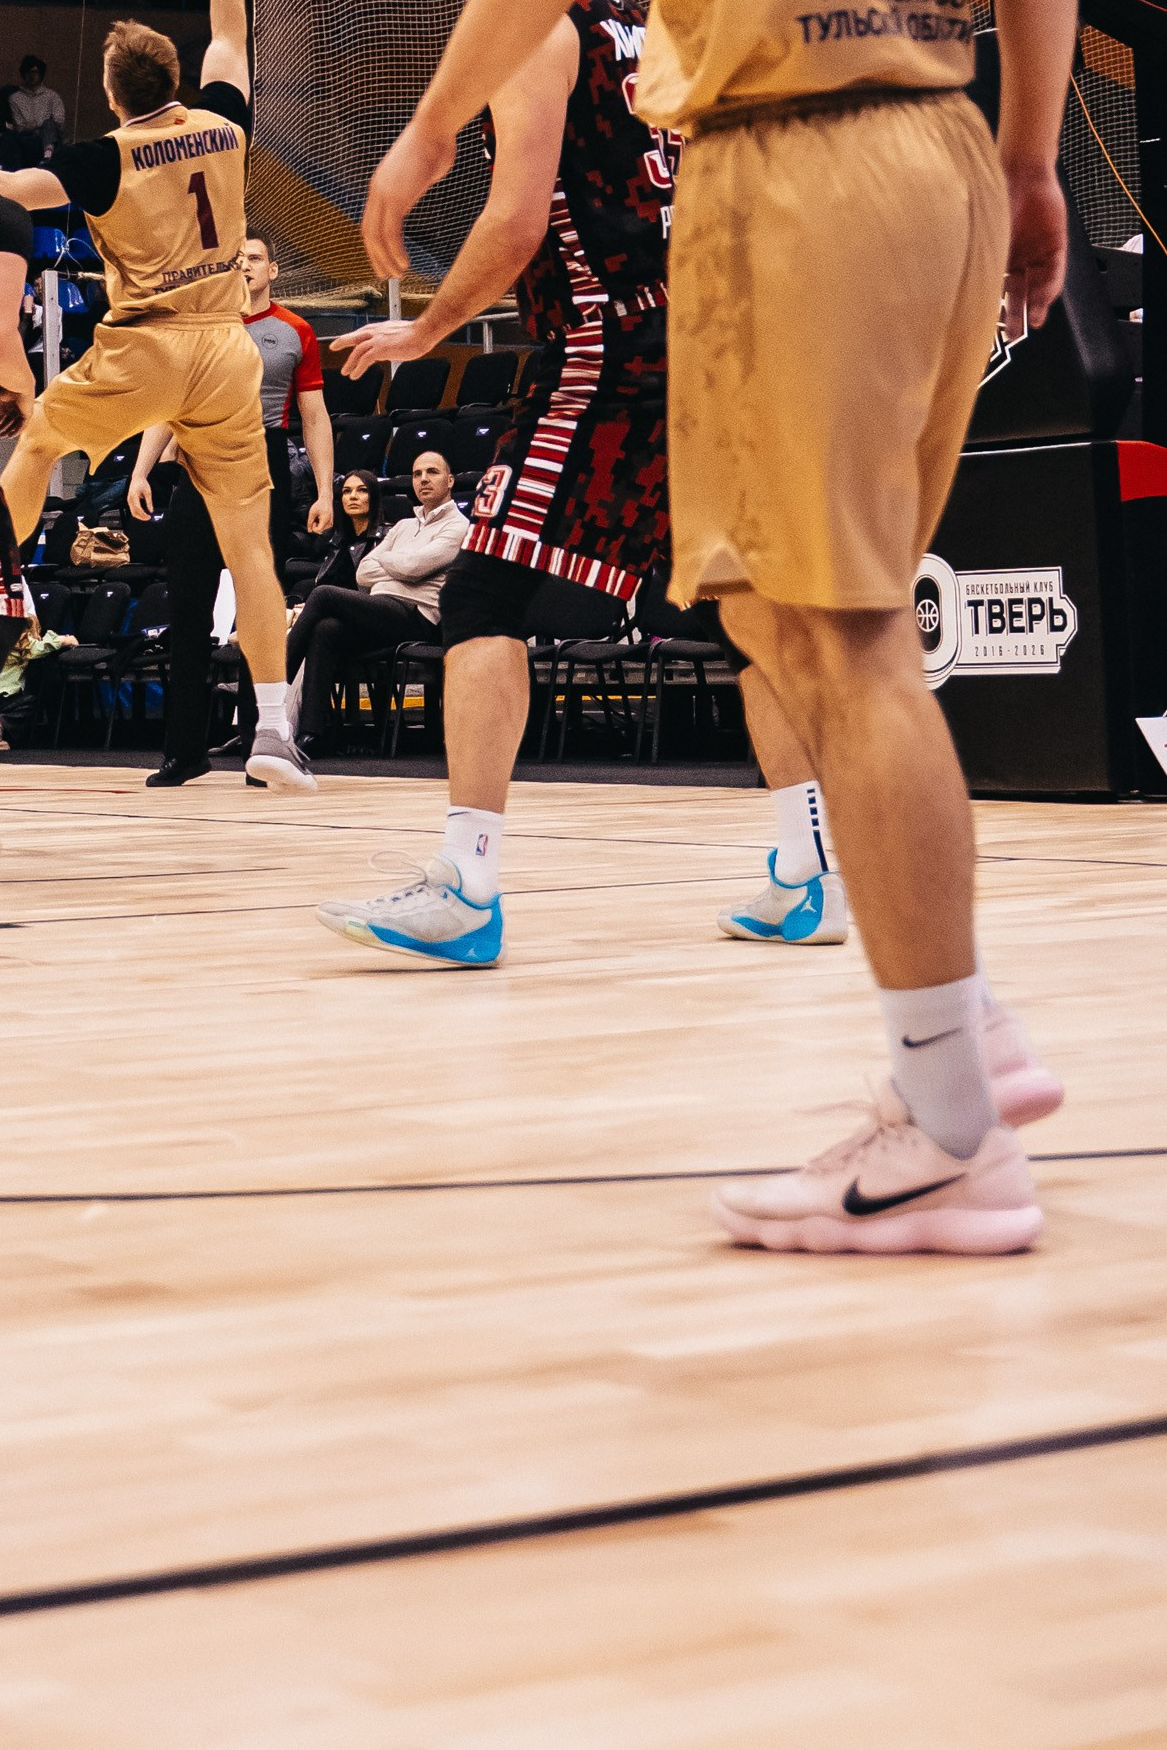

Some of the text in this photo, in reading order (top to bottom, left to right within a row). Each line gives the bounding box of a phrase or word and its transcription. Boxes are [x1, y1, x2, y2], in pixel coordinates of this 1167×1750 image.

[131, 123, 239, 172] КОЛОМЕНСКИЙ
[187, 171, 219, 250] 1
[471, 464, 513, 518] 3
[965, 580, 1054, 596] БАСКЕТБОЛЬНЫЙ КЛУБ
[965, 596, 1068, 636] ТВЕРЬ
[975, 644, 1045, 657] 2016-2026
